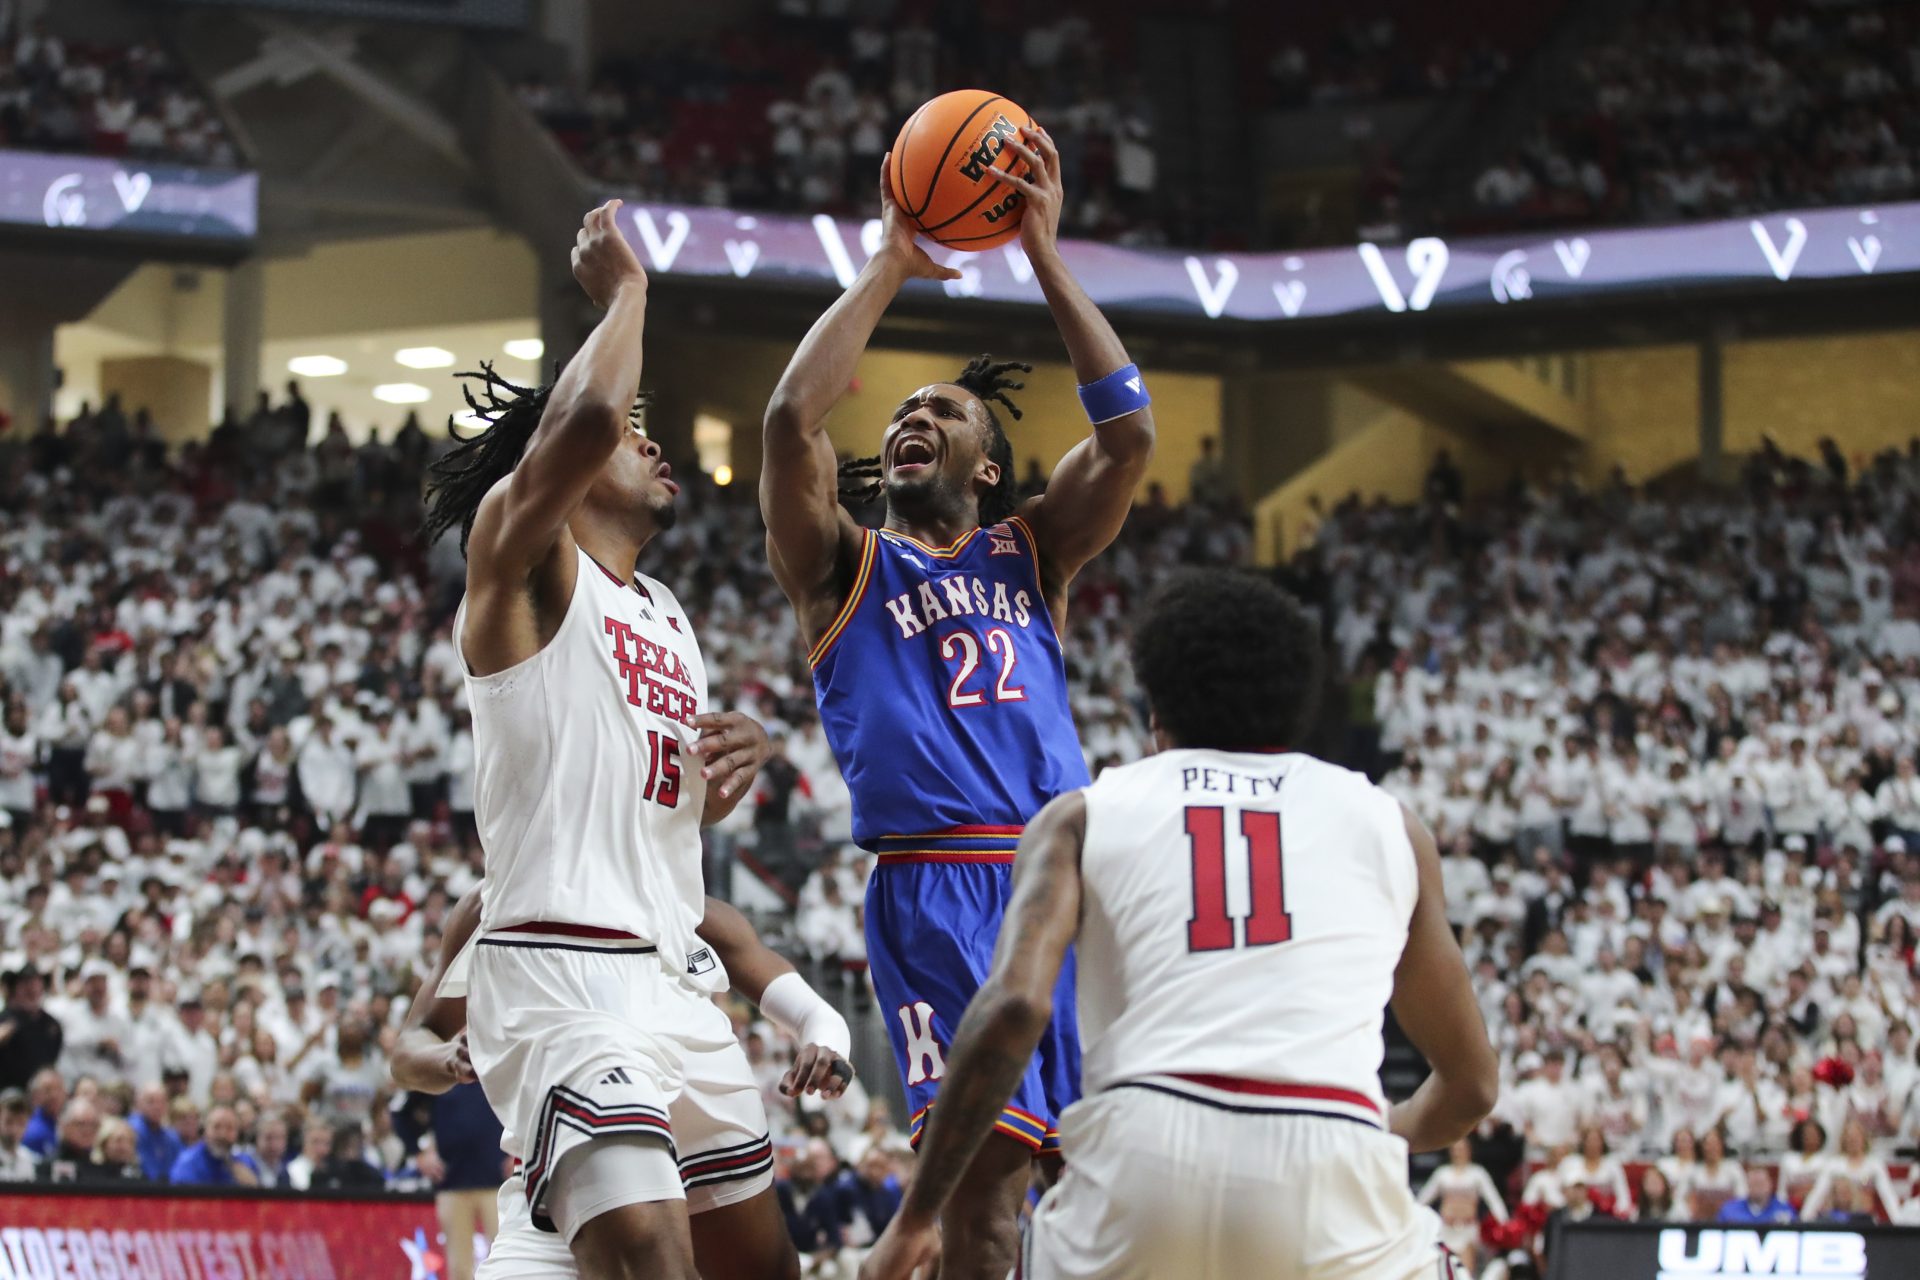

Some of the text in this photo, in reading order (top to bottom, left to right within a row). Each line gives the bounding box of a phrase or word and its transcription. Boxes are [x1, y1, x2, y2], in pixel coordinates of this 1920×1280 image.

[959, 113, 1018, 183] NCAA
[885, 575, 1032, 639] KANSAS
[619, 658, 698, 731] TECH
[940, 627, 1027, 708] 22
[643, 729, 681, 809] 15
[1182, 767, 1285, 796] PETTY
[1184, 805, 1292, 954] 11
[1658, 1228, 1868, 1274] UMB
